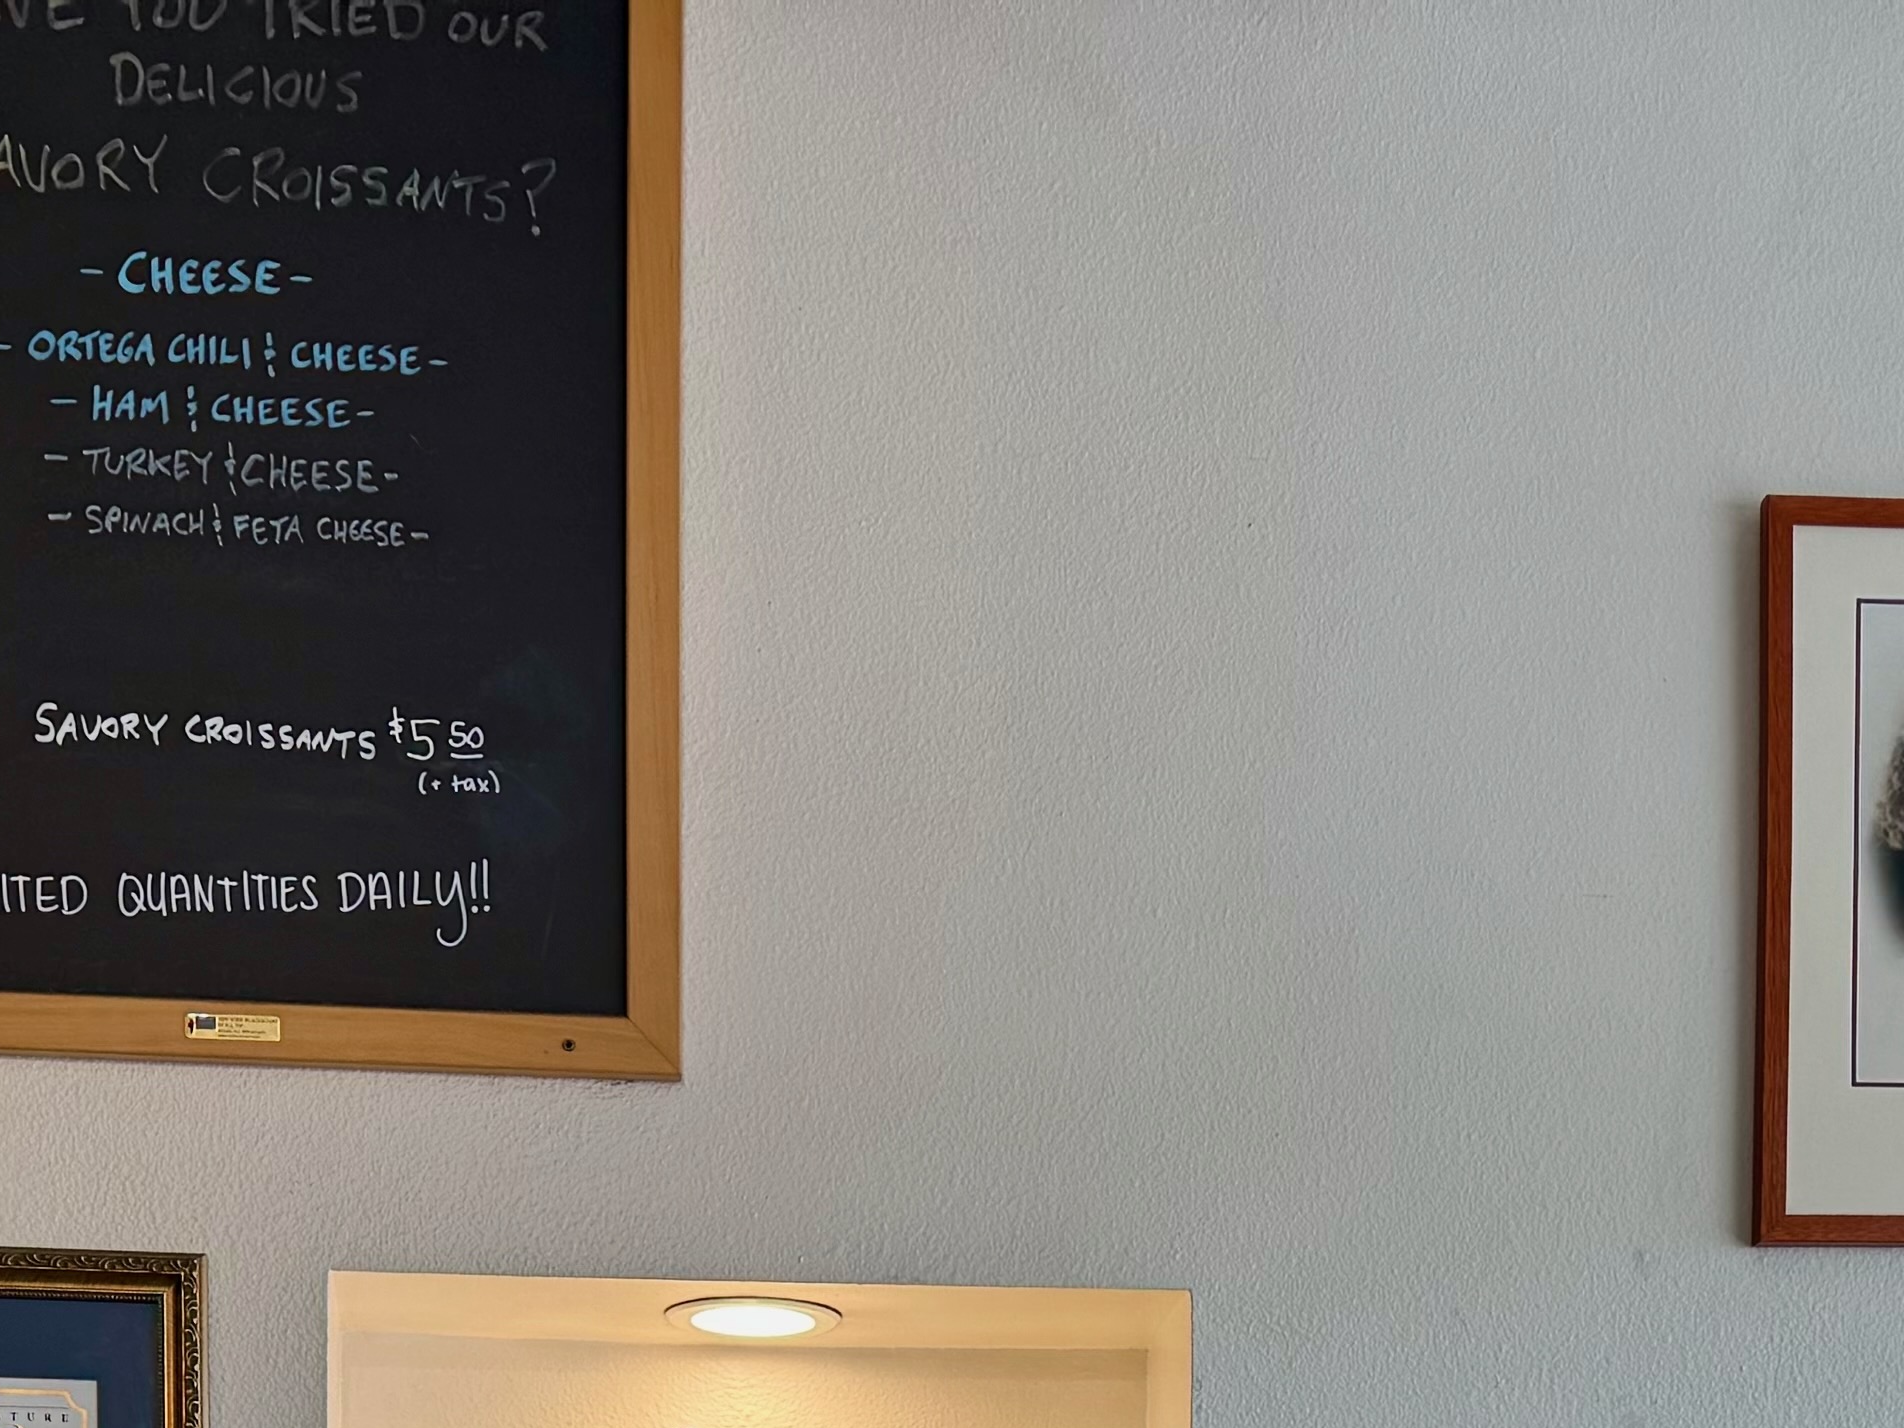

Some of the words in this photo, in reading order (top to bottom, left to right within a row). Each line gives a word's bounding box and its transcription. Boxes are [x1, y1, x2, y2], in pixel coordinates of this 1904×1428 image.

[448, 11, 548, 51] OUR
[109, 52, 362, 112] DELICIOUS
[203, 147, 556, 236] CROISSANTS?
[28, 330, 155, 366] ORTEGA
[168, 334, 251, 369] CHILI
[93, 385, 169, 424] HAM
[83, 447, 212, 484] TURKEY
[86, 505, 203, 536] SPINACH
[234, 515, 303, 544] FETA
[35, 703, 168, 745] SAVORY
[185, 715, 375, 760] CROISSANTS
[118, 871, 318, 916] QUANTITIES
[338, 859, 490, 946] DAILY!!
